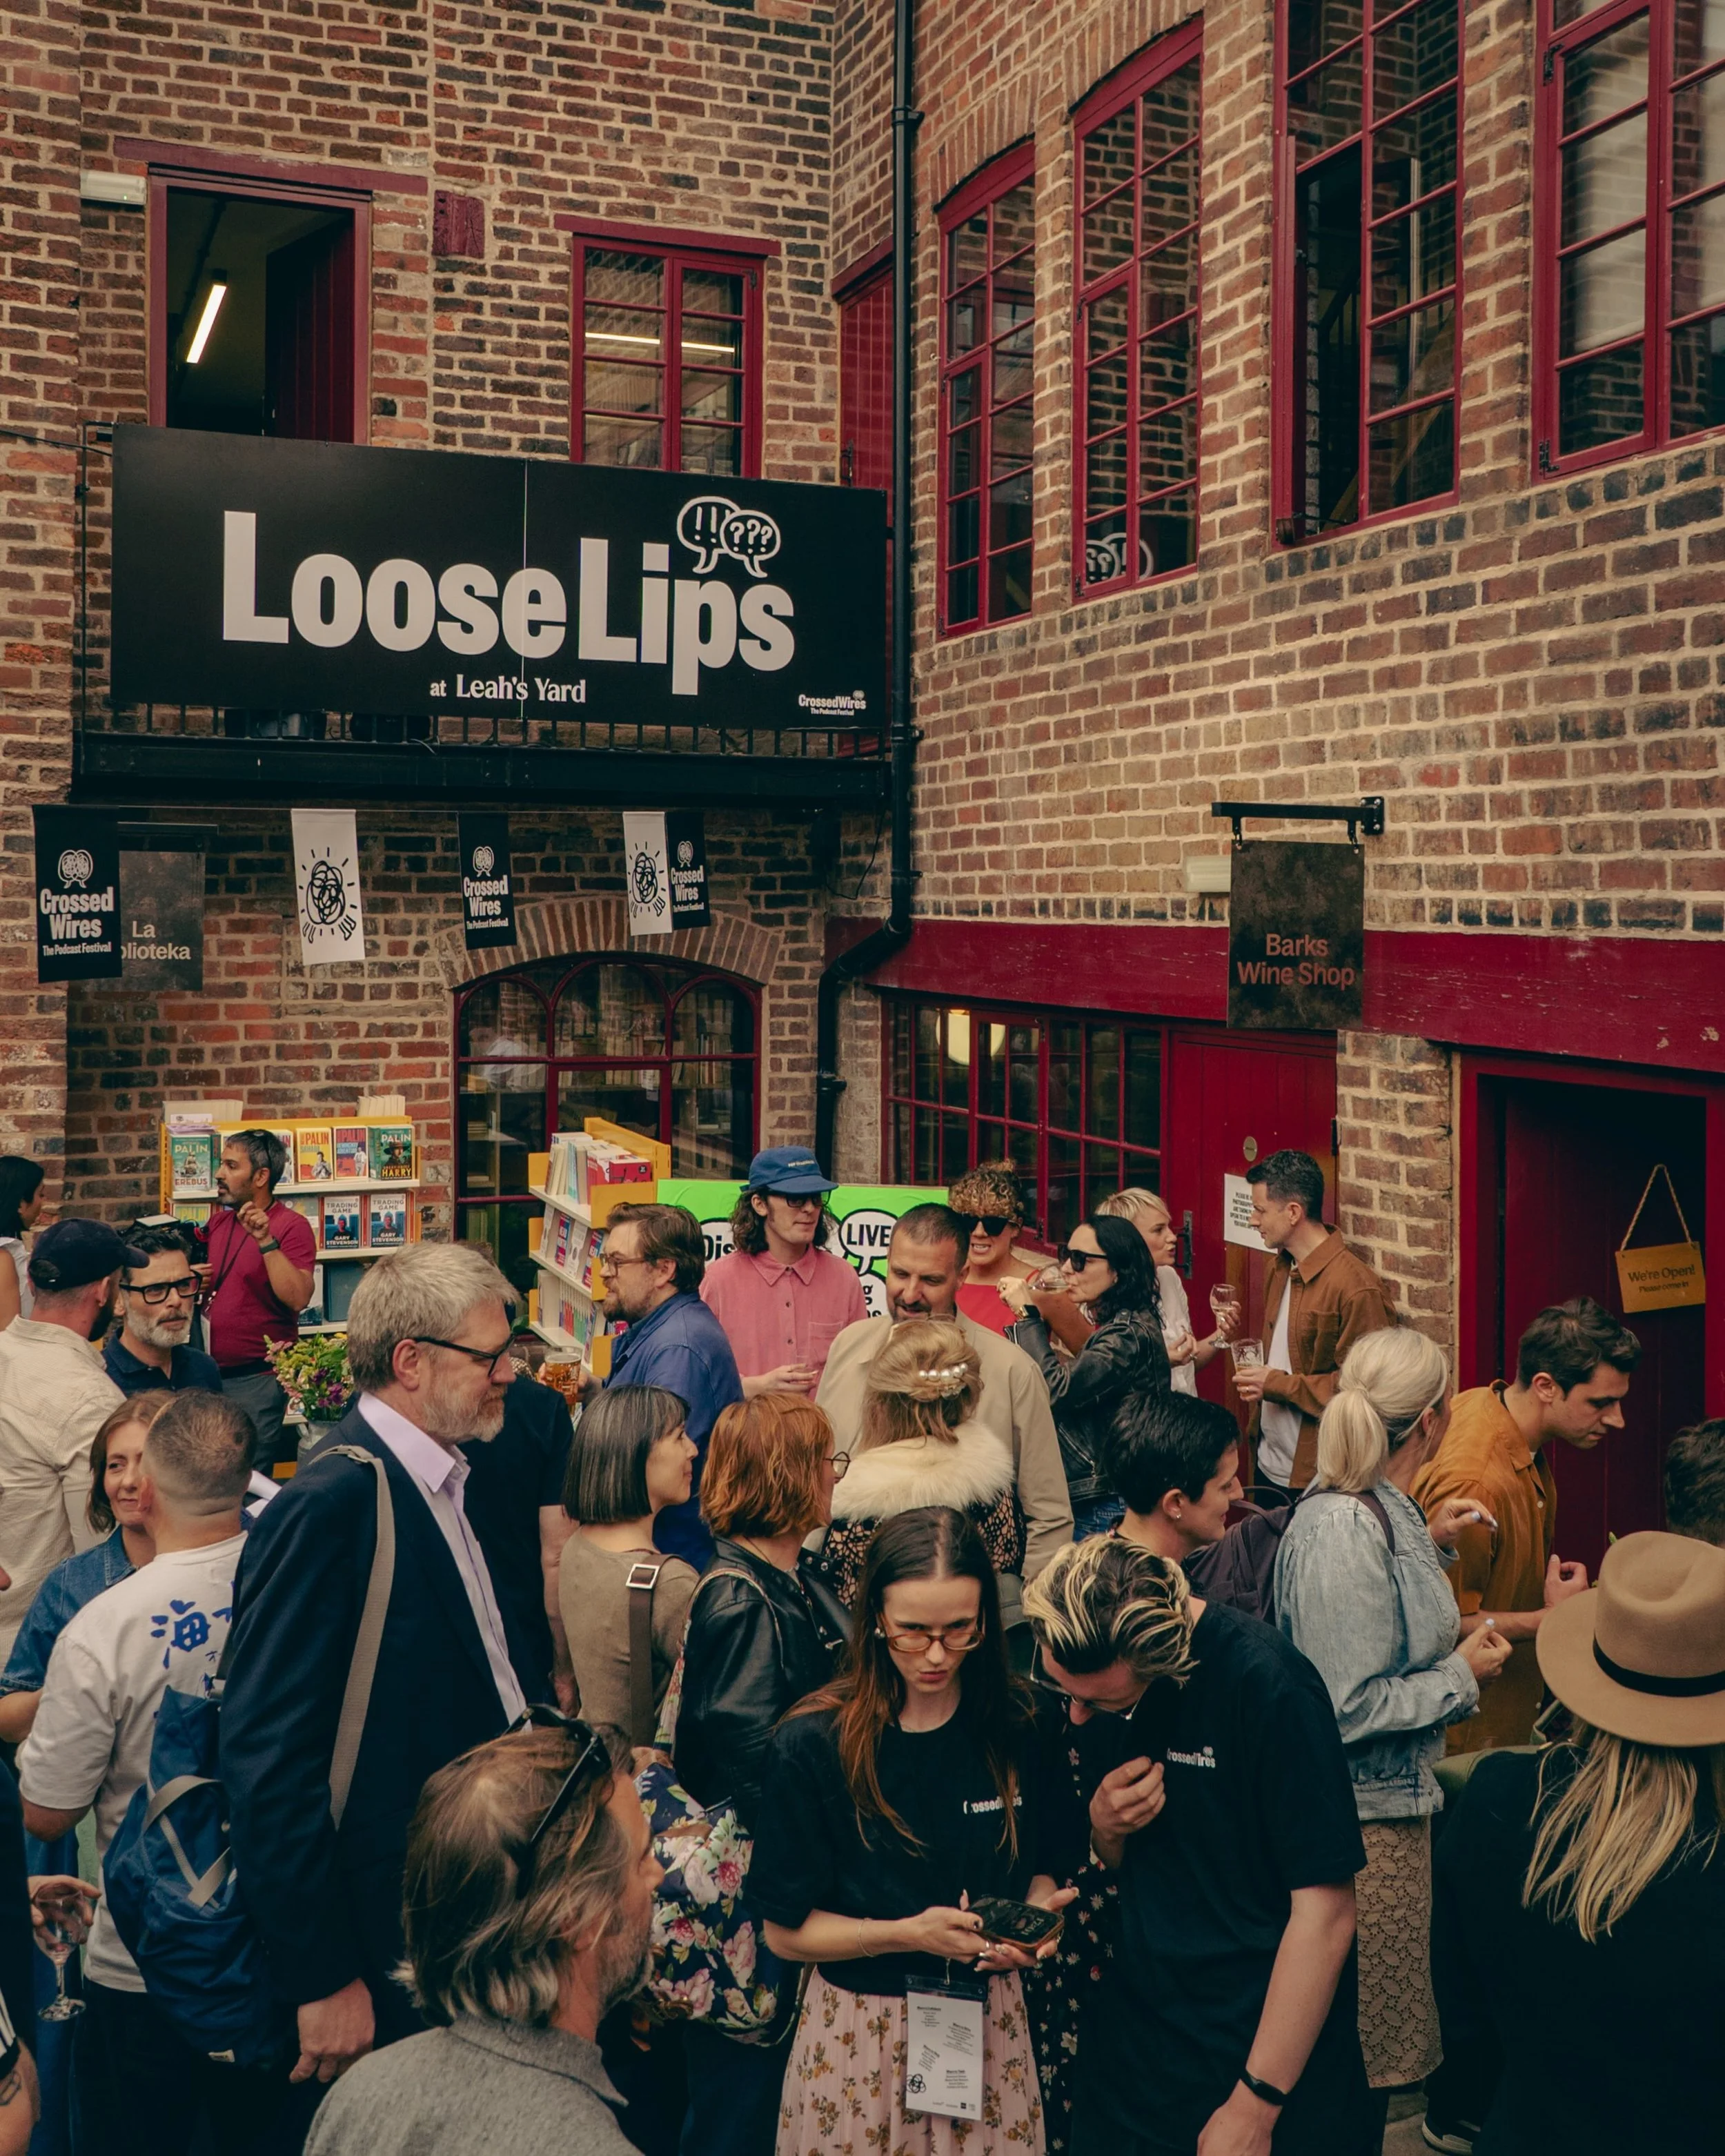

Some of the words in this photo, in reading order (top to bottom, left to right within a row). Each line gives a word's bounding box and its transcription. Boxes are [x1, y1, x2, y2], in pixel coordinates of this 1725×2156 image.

[430, 680, 447, 697] at
[456, 673, 529, 700] Leah's
[534, 678, 586, 703] Yard
[671, 864, 704, 884] Crossed
[463, 875, 509, 897] Crossed
[675, 884, 699, 902] Wires
[40, 886, 114, 914] Crossed
[469, 896, 502, 917] Wires
[50, 913, 102, 940] Wires
[132, 920, 156, 938] La
[43, 944, 54, 956] The
[55, 943, 81, 955] Podcast
[81, 942, 112, 953] Festival
[1265, 933, 1329, 956] Barks
[1237, 961, 1294, 985] Wine
[1298, 962, 1357, 991] Shop
[306, 1132, 330, 1145] PALIN
[381, 1134, 412, 1143] PALIN
[175, 1144, 208, 1154] PALIN
[175, 1178, 208, 1186] EREBUS
[382, 1168, 412, 1177] HARRY
[846, 1223, 891, 1247] LIVE
[1627, 1269, 1659, 1283] We're
[1662, 1264, 1696, 1280] Open!
